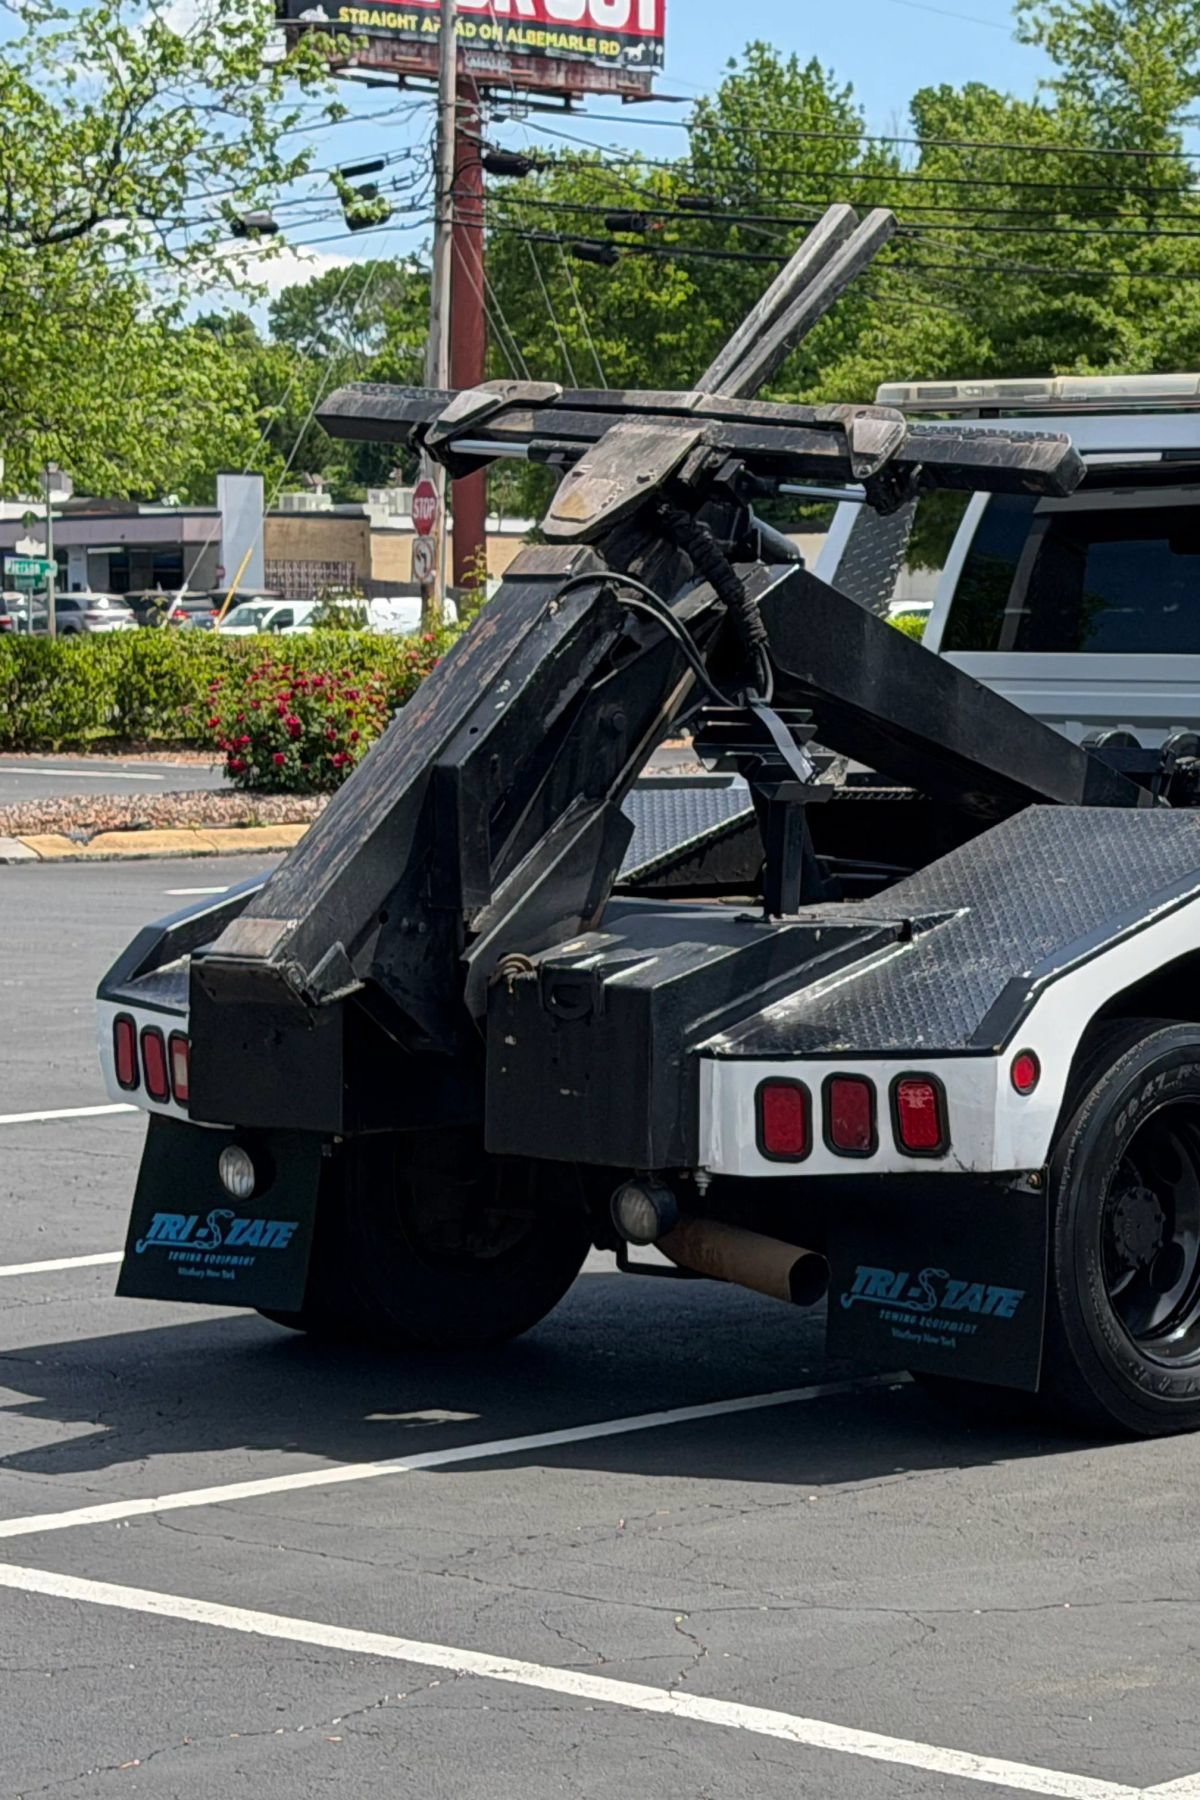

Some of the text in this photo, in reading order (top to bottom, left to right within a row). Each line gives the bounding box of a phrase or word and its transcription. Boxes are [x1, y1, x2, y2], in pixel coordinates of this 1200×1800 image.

[338, 6, 419, 31] STRAIGHT
[421, 16, 477, 38] AAD
[479, 23, 503, 42] ON
[506, 28, 597, 54] ALBEMARLE
[599, 39, 620, 56] RD
[413, 498, 435, 519] STOP
